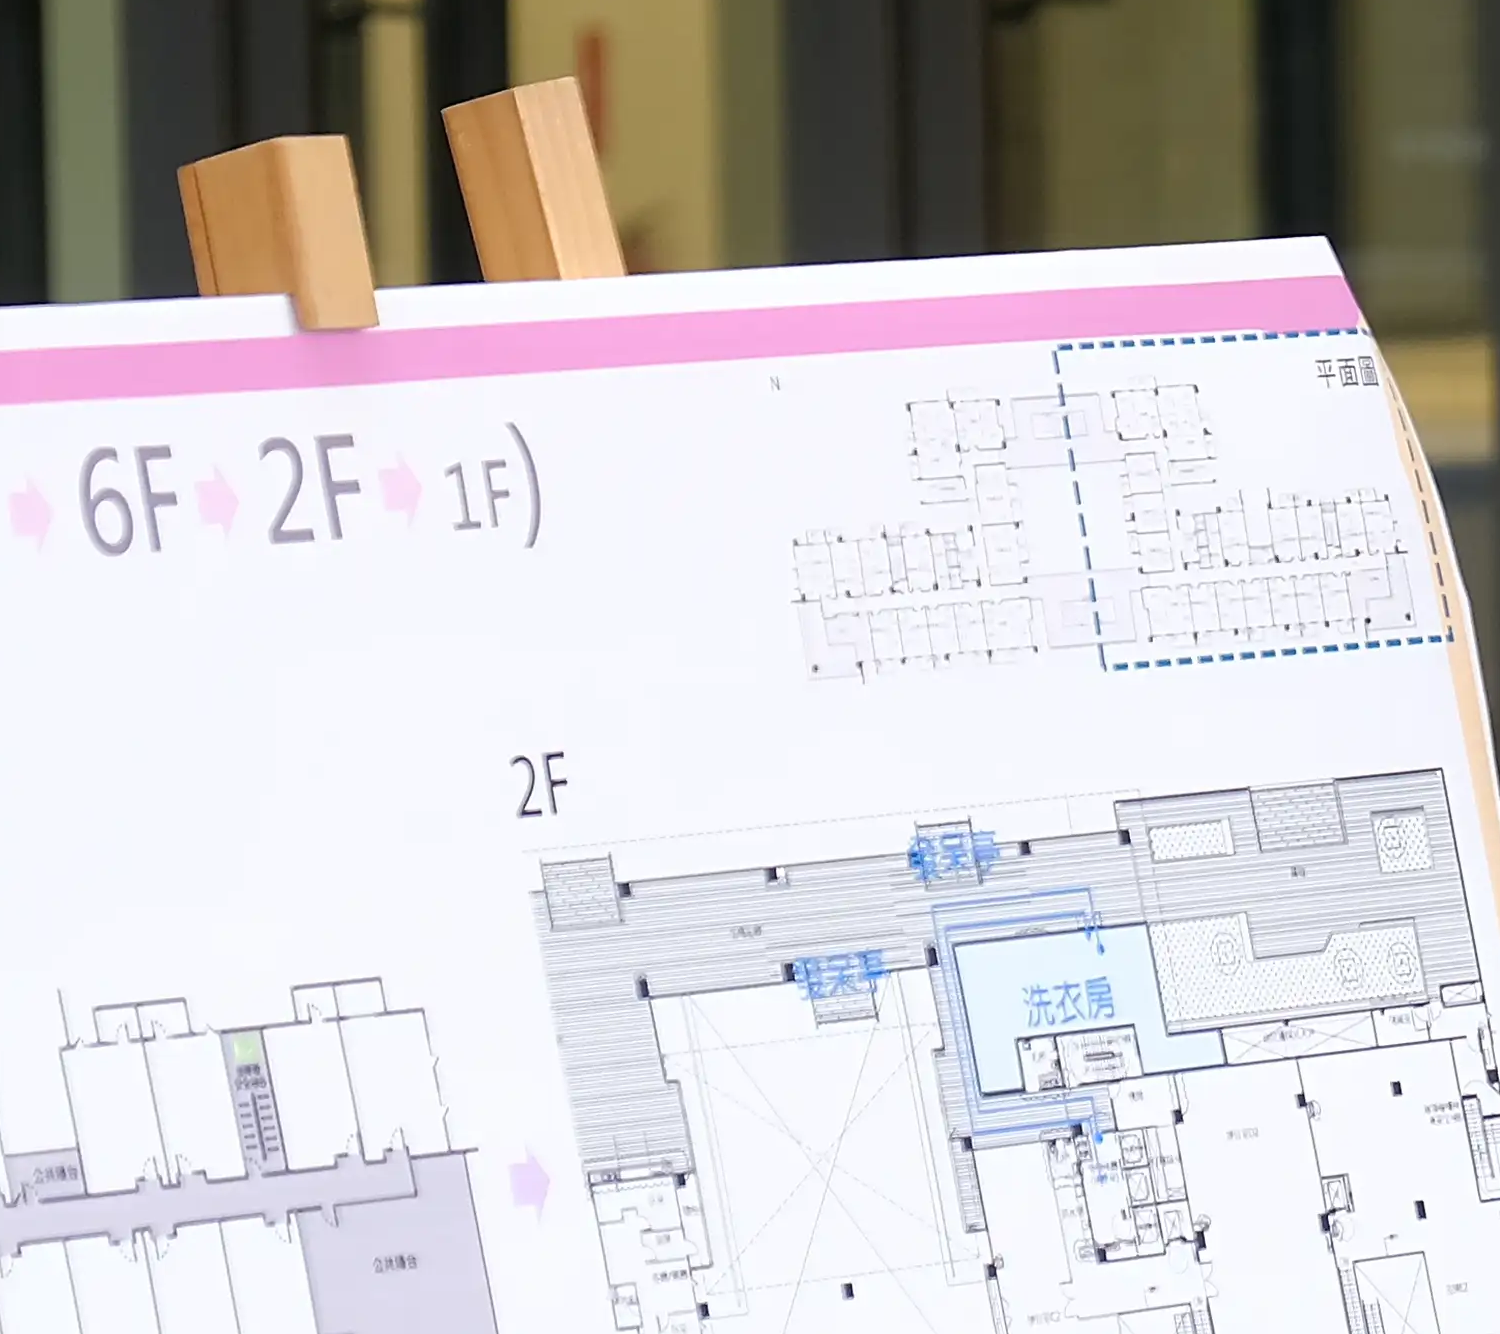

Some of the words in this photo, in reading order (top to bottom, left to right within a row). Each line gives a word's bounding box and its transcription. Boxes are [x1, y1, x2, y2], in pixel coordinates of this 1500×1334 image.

[1315, 356, 1379, 388] 平面圖
[77, 443, 179, 558] 6F
[256, 433, 363, 547] 2F
[509, 751, 568, 818] 2F
[1021, 976, 1116, 1028] 洗衣房
